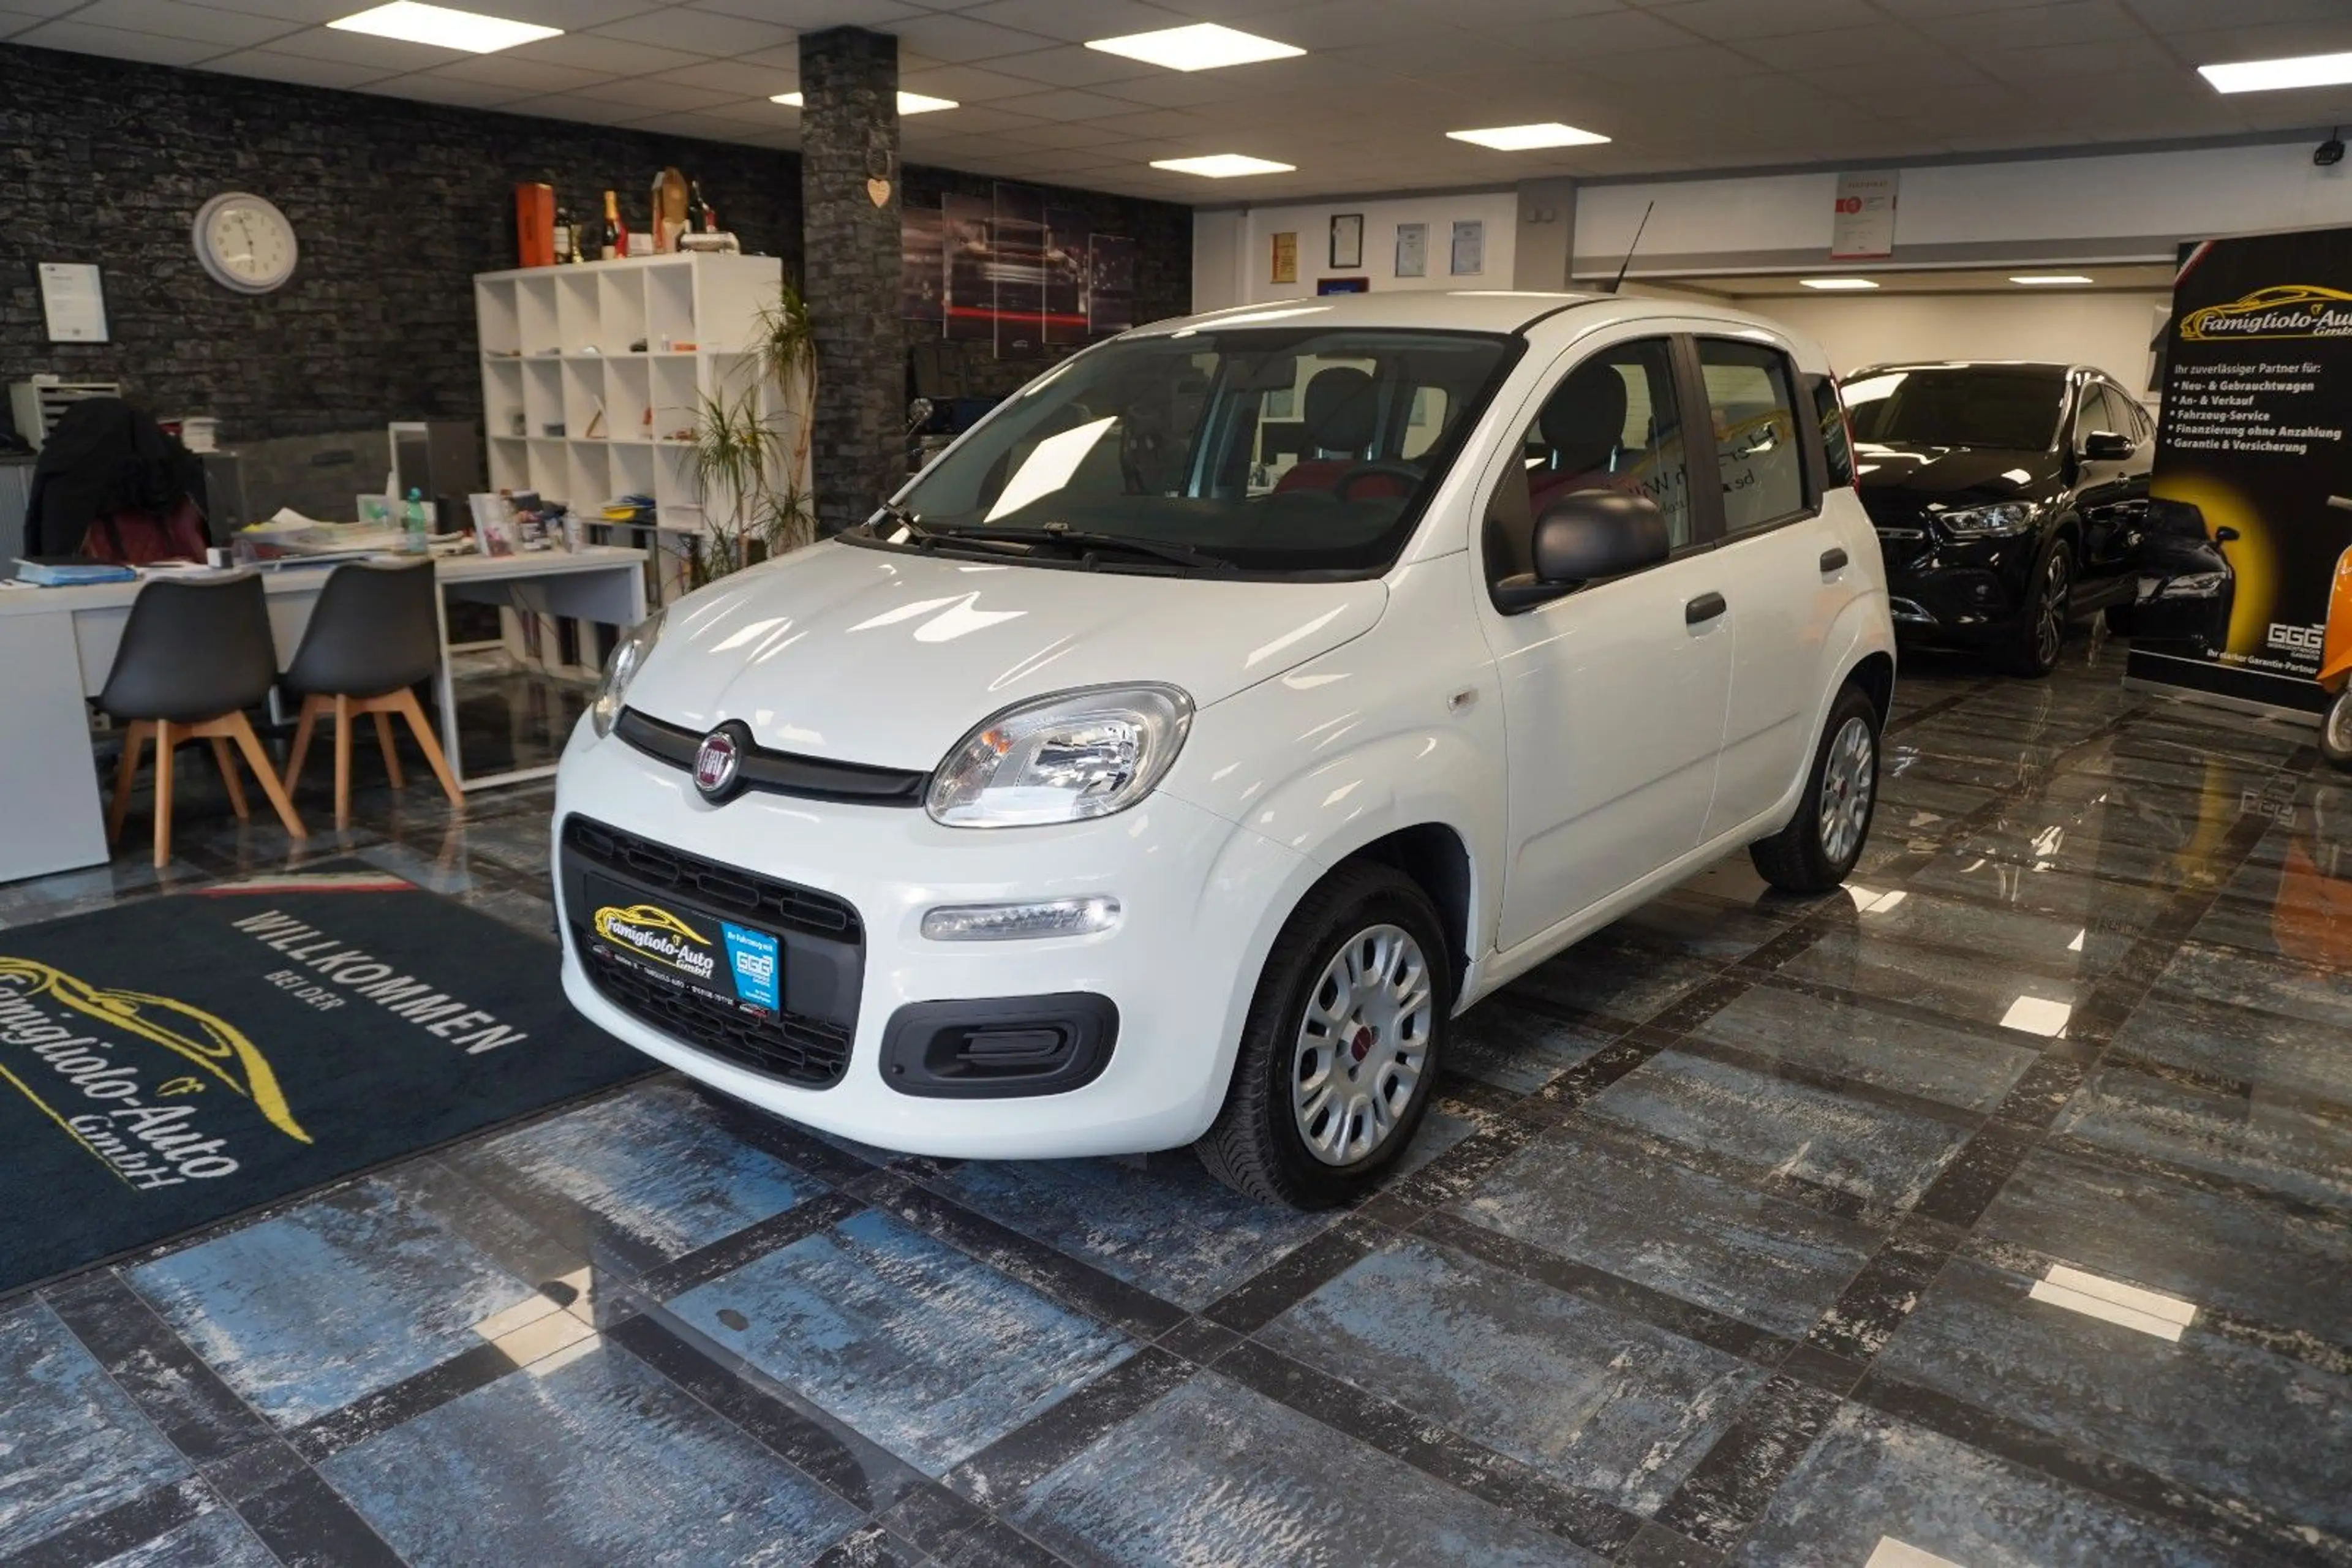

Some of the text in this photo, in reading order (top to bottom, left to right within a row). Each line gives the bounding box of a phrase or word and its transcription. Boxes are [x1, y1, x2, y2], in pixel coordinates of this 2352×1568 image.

[2201, 310, 2352, 333] Famigliolo-Au
[2175, 362, 2321, 375] Ihr zuverlässiger Partner für:
[2180, 380, 2315, 393] Neu- & Gebrauchtwagen
[2178, 395, 2255, 405] An- & Verkauf
[2177, 409, 2271, 422] Fahrzeug-Service
[2175, 424, 2343, 441] Finanzierung ohne Anzahlung
[2174, 438, 2308, 455] Garantie & Versicherung
[2267, 623, 2324, 649] GGG
[2247, 655, 2318, 674] Garantie-Partner
[608, 916, 714, 970] Famigliolo-Auto
[676, 959, 712, 979] GmbH
[232, 910, 529, 1055] WILLKOMMEN
[264, 970, 347, 1011] BEI DER
[69, 1115, 186, 1190] GmbH
